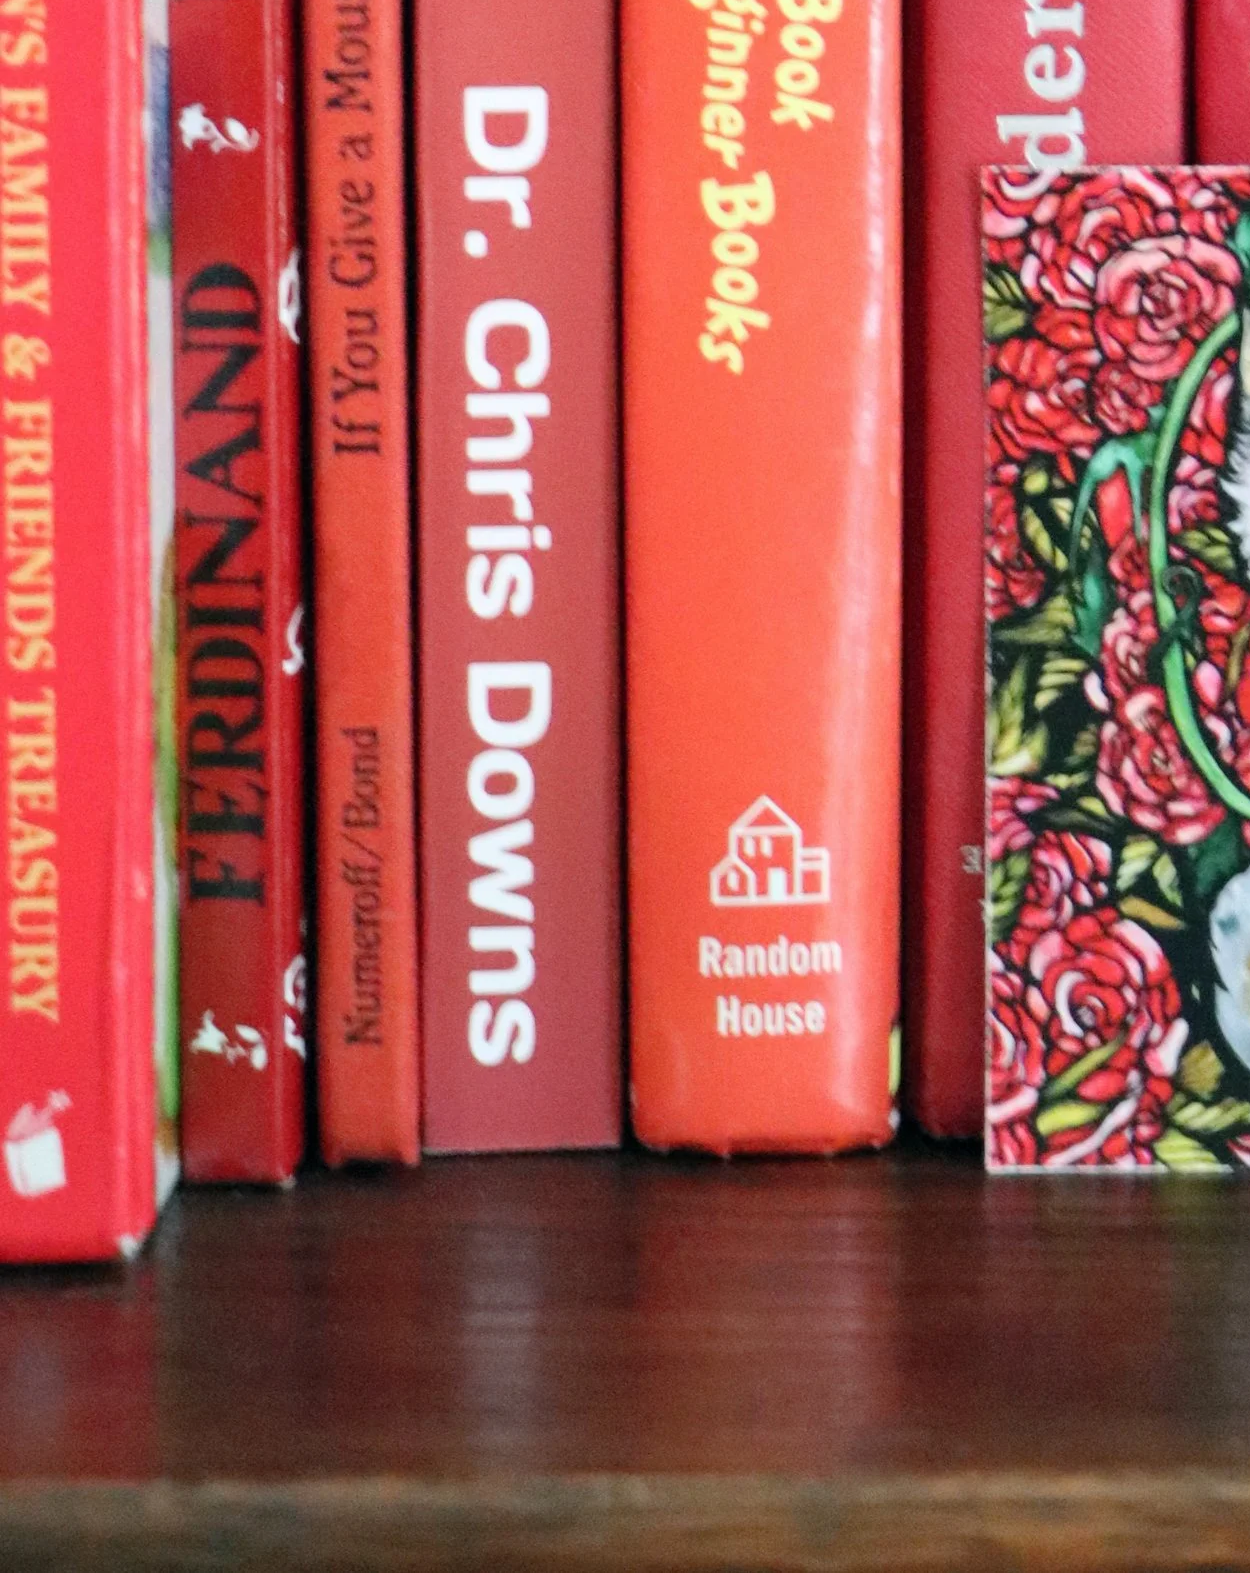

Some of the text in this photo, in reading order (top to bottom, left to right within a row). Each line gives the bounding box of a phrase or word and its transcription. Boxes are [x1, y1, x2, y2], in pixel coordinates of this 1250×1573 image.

[0, 87, 50, 314] FAMILY
[339, 134, 372, 160] a
[327, 180, 378, 290] Give
[699, 171, 775, 374] Books
[2, 334, 49, 379] &
[330, 309, 380, 404] You
[331, 415, 380, 454] If
[4, 400, 54, 670] FRIENDS
[182, 263, 268, 907] FERDINAND
[463, 86, 551, 1065] Dr. Chris Downs
[8, 688, 58, 1021] TREASURY
[340, 727, 384, 1047] Numeroff/Bond
[699, 935, 842, 978] Random
[717, 996, 827, 1036] House
